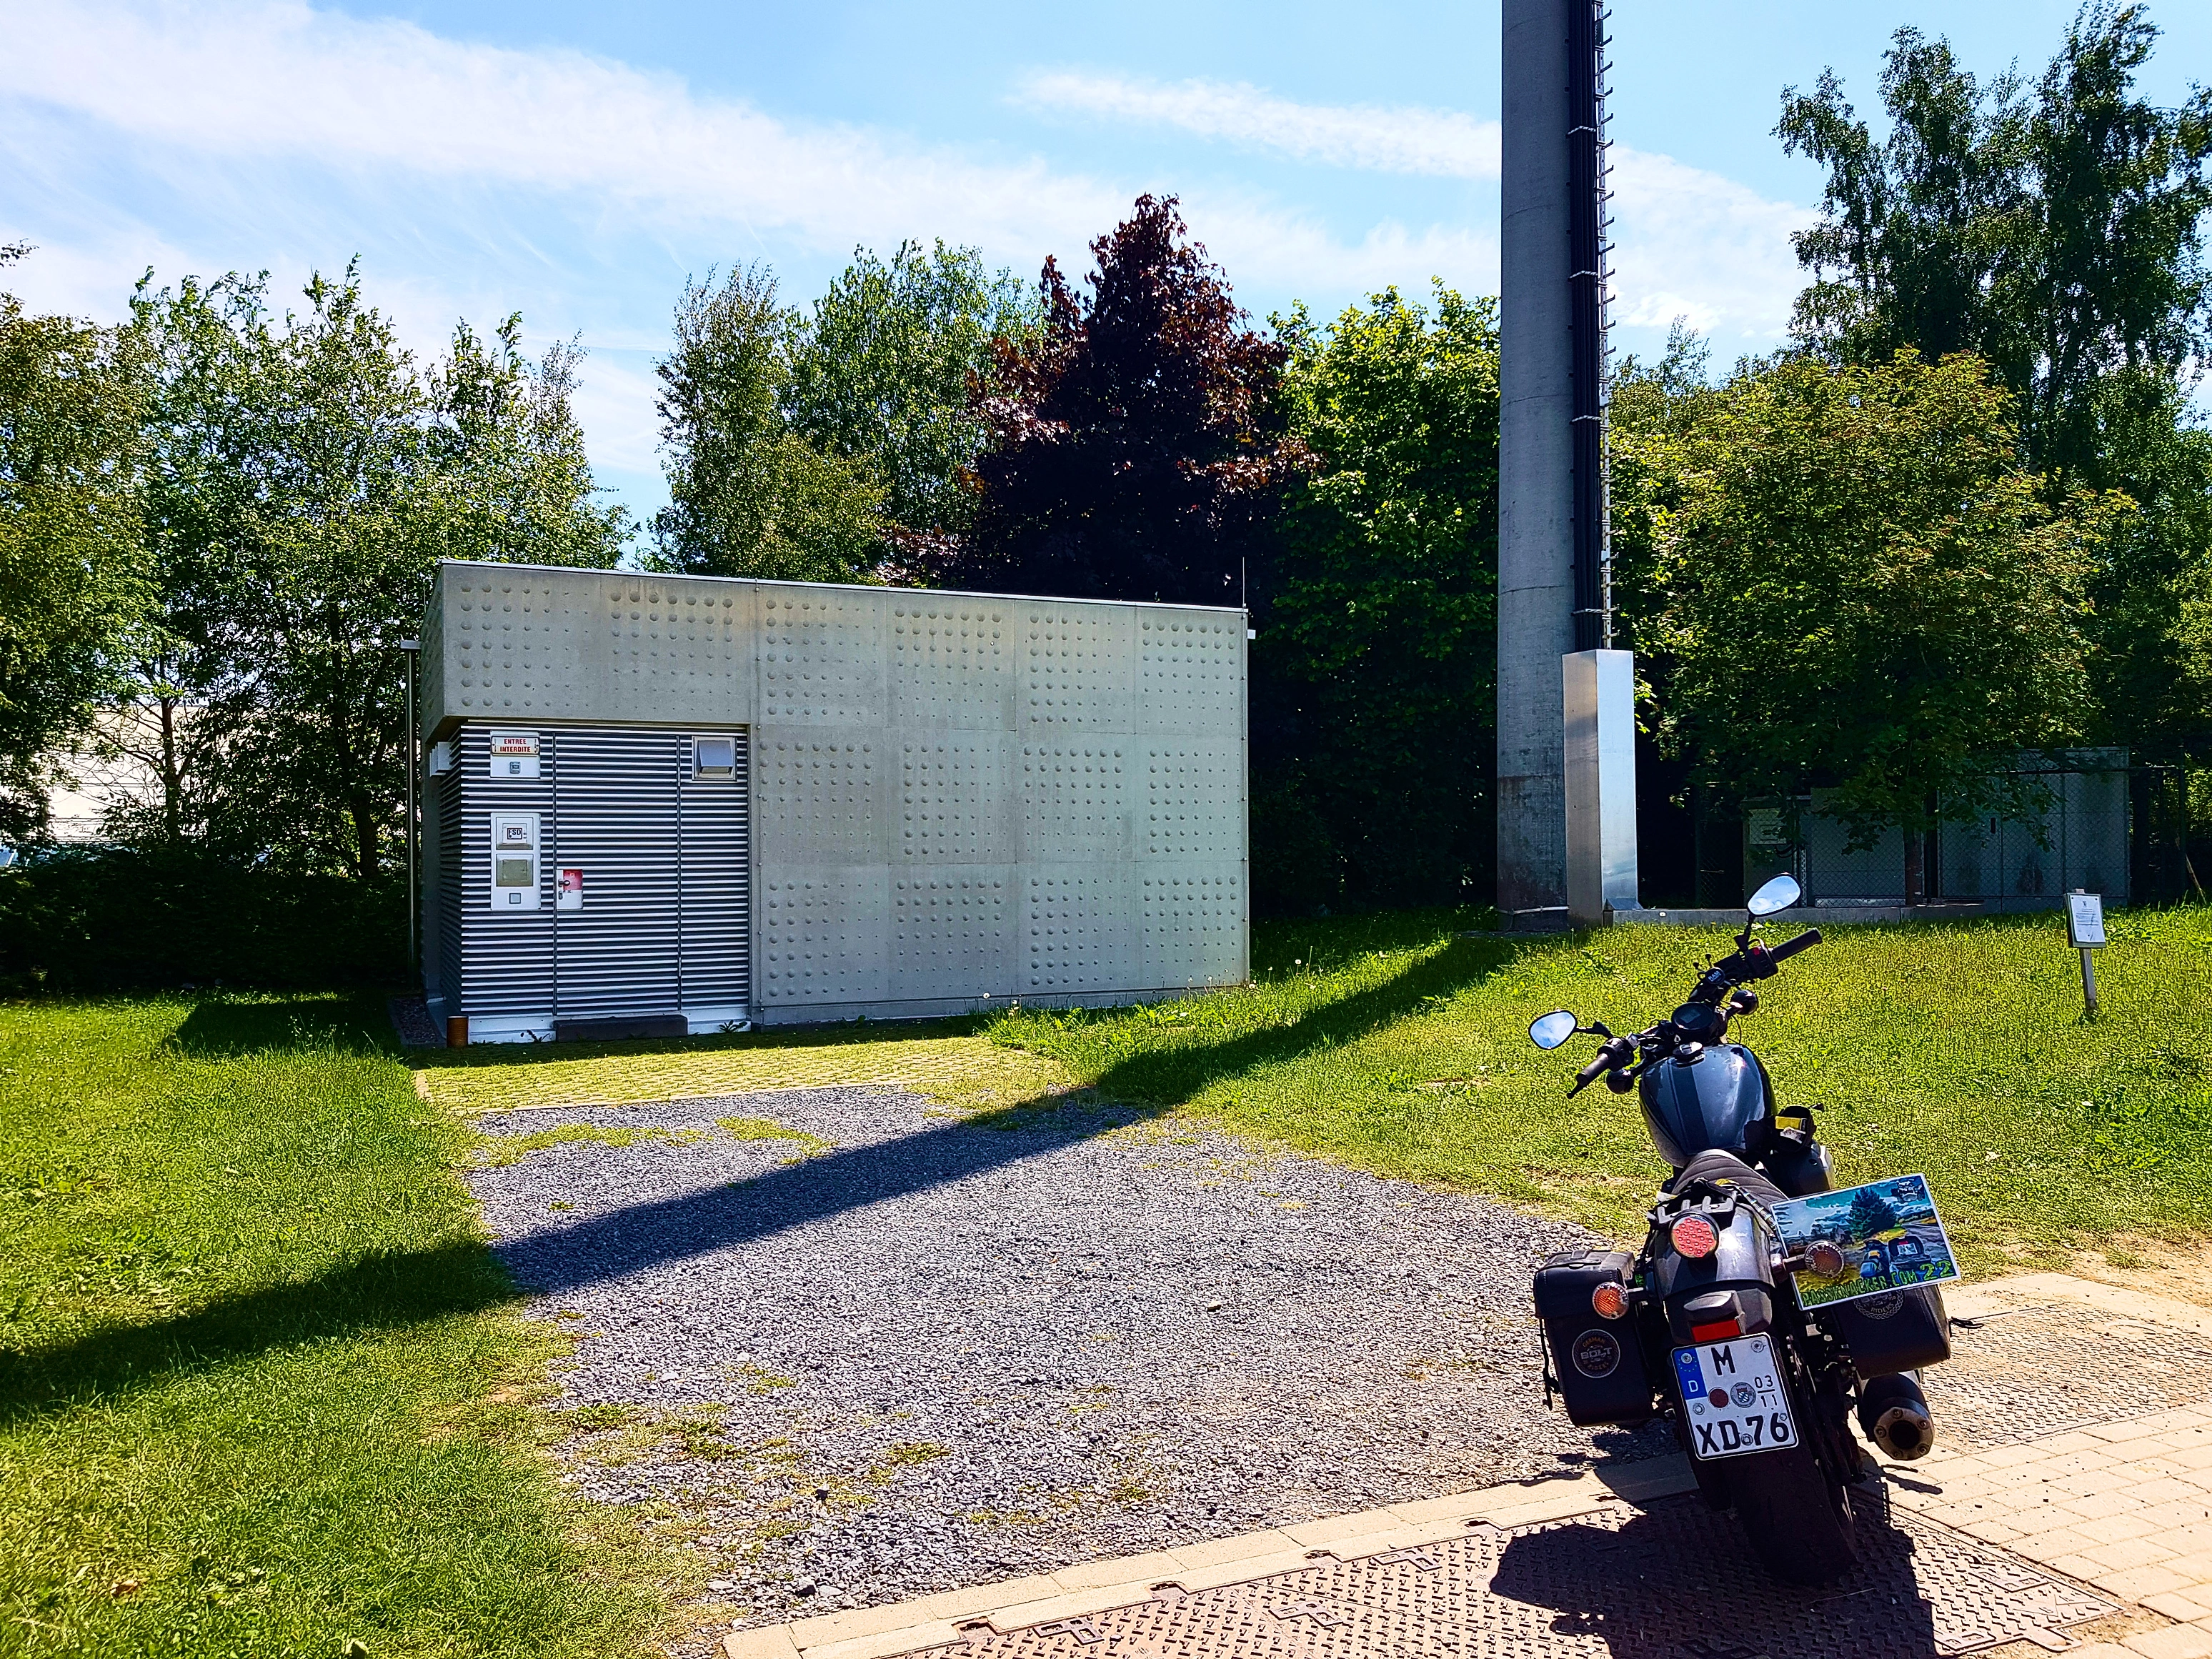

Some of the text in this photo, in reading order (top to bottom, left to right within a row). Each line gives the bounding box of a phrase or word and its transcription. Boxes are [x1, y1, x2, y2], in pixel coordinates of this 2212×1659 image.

[1919, 1260, 1955, 1281] 22
[1870, 1302, 1895, 1313] RIDERS
[1580, 1347, 1613, 1360] BOLT
[1710, 1345, 1736, 1376] M
[1688, 1380, 1699, 1393] D
[1754, 1375, 1774, 1389] 03
[1760, 1394, 1778, 1408] 11
[1745, 1412, 1790, 1446] 76
